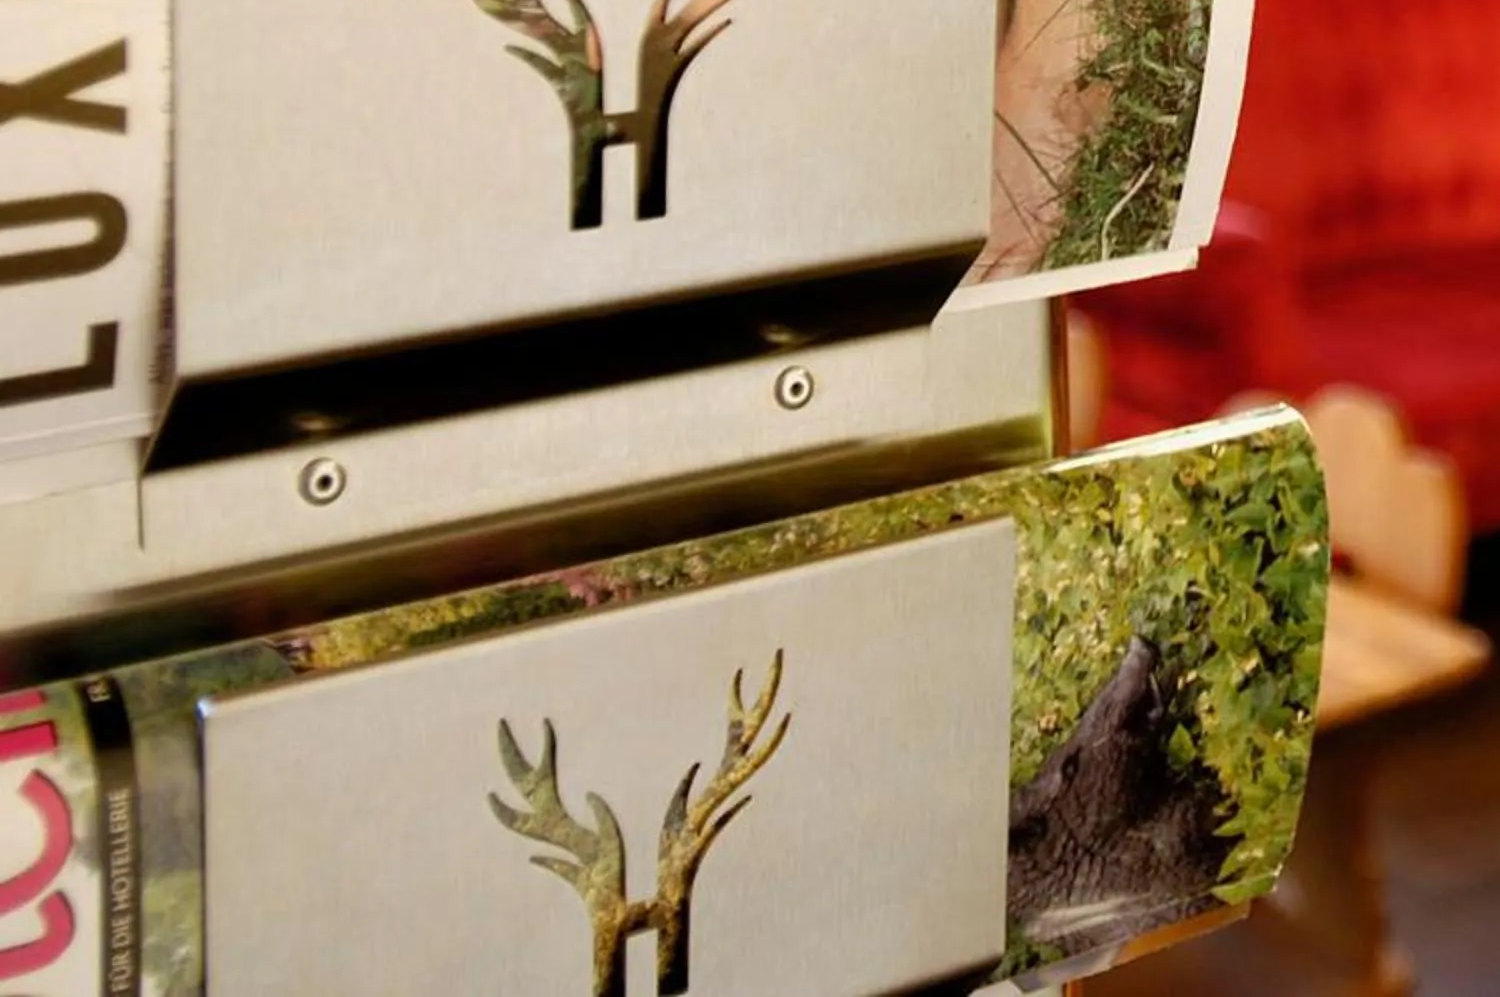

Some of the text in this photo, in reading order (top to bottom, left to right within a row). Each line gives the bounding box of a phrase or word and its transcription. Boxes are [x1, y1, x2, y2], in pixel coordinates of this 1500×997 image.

[108, 789, 133, 993] FÜR DIE HOTELLERIE
